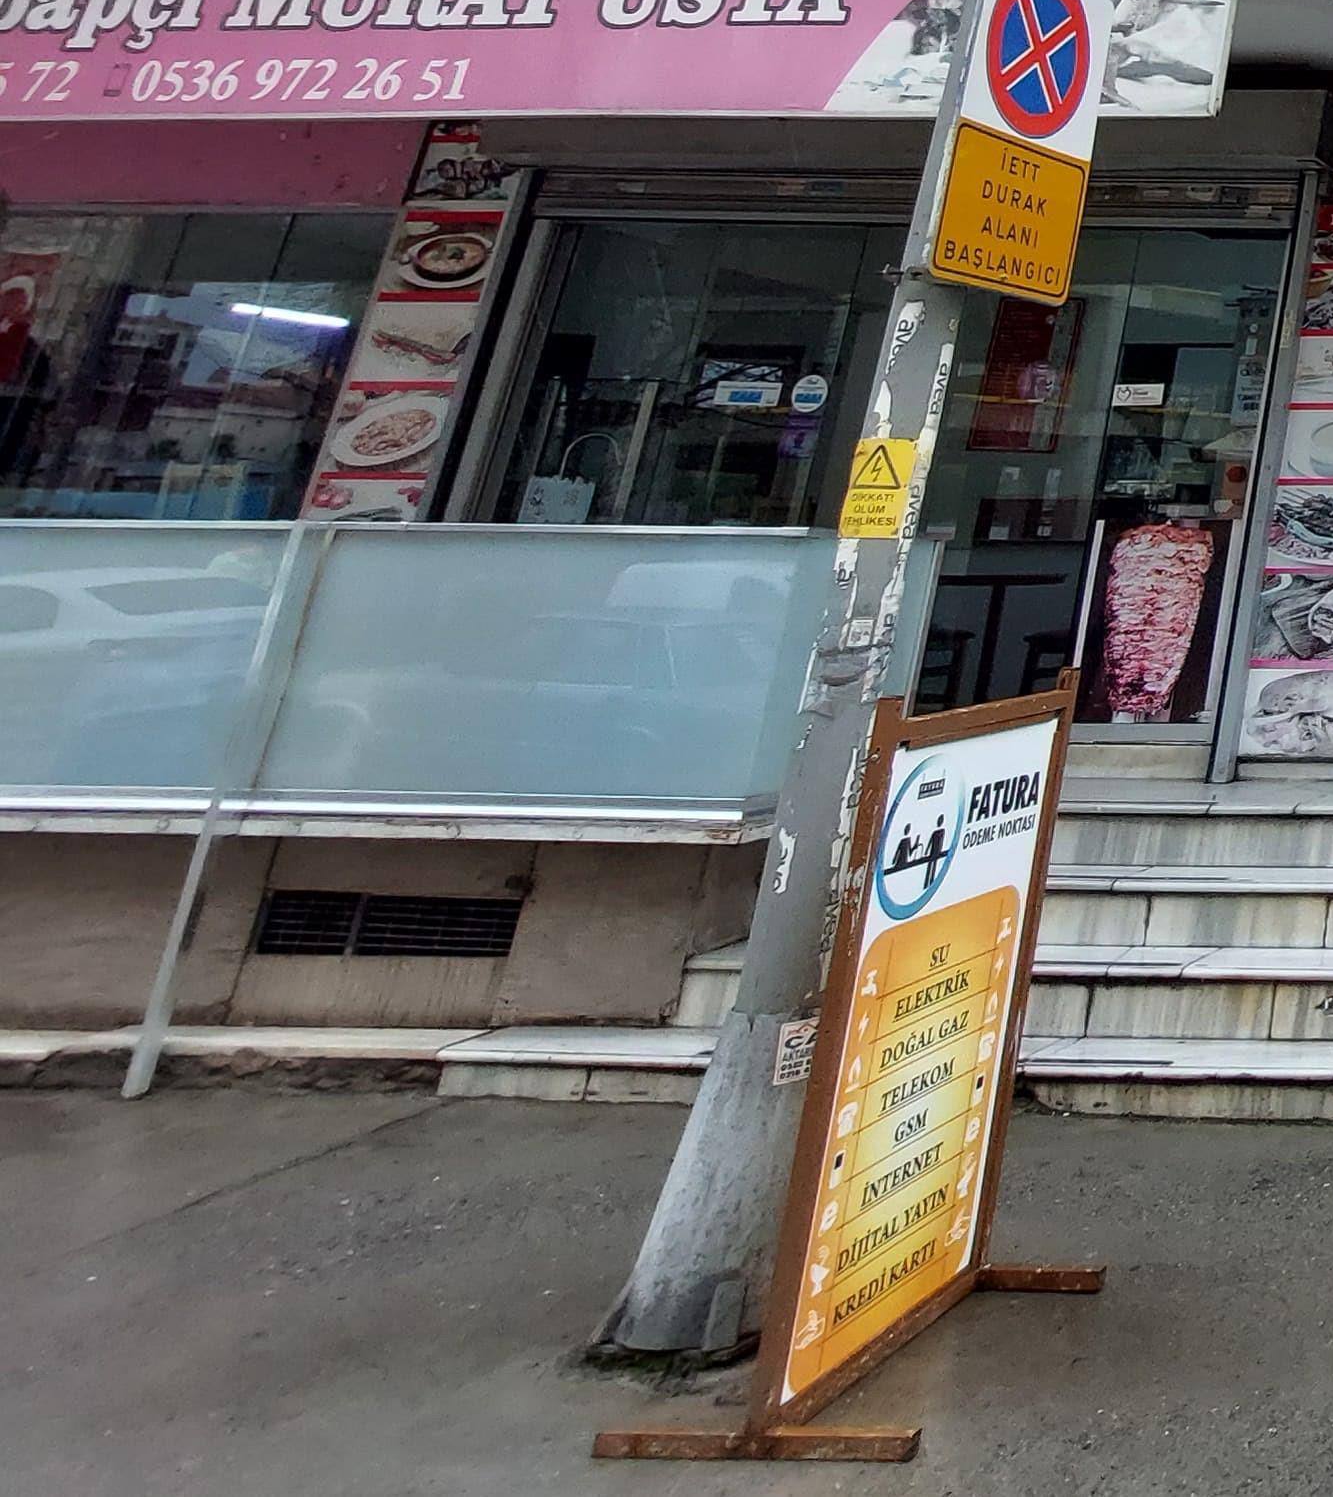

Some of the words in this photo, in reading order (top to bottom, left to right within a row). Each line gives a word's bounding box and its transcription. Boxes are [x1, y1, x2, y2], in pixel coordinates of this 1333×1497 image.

[22, 61, 81, 102] 72
[131, 59, 245, 101] 0536
[249, 59, 339, 100] 972
[342, 59, 407, 100] 26
[412, 58, 472, 100] 51
[1000, 147, 1041, 183] İETT
[982, 180, 1049, 217] DURAK
[981, 216, 1039, 250] ALANI
[944, 240, 1061, 287] BAŞLANGICI
[966, 771, 1040, 824] FATURA
[962, 825, 997, 850] ÖDEME
[997, 813, 1037, 840] NOKTASI
[928, 942, 952, 970] SU
[893, 969, 971, 1022] ELEKTRİK
[879, 1026, 936, 1070] DOĞAL
[938, 1009, 970, 1044] GAZ
[879, 1057, 956, 1114] TELEKOM
[893, 1108, 930, 1145] GSM
[860, 1142, 944, 1208] İNTERNET
[836, 1216, 901, 1274] DİJİTAL
[902, 1183, 951, 1231] YAYIN
[832, 1270, 888, 1326] KREDİ
[887, 1240, 937, 1288] KARTI
